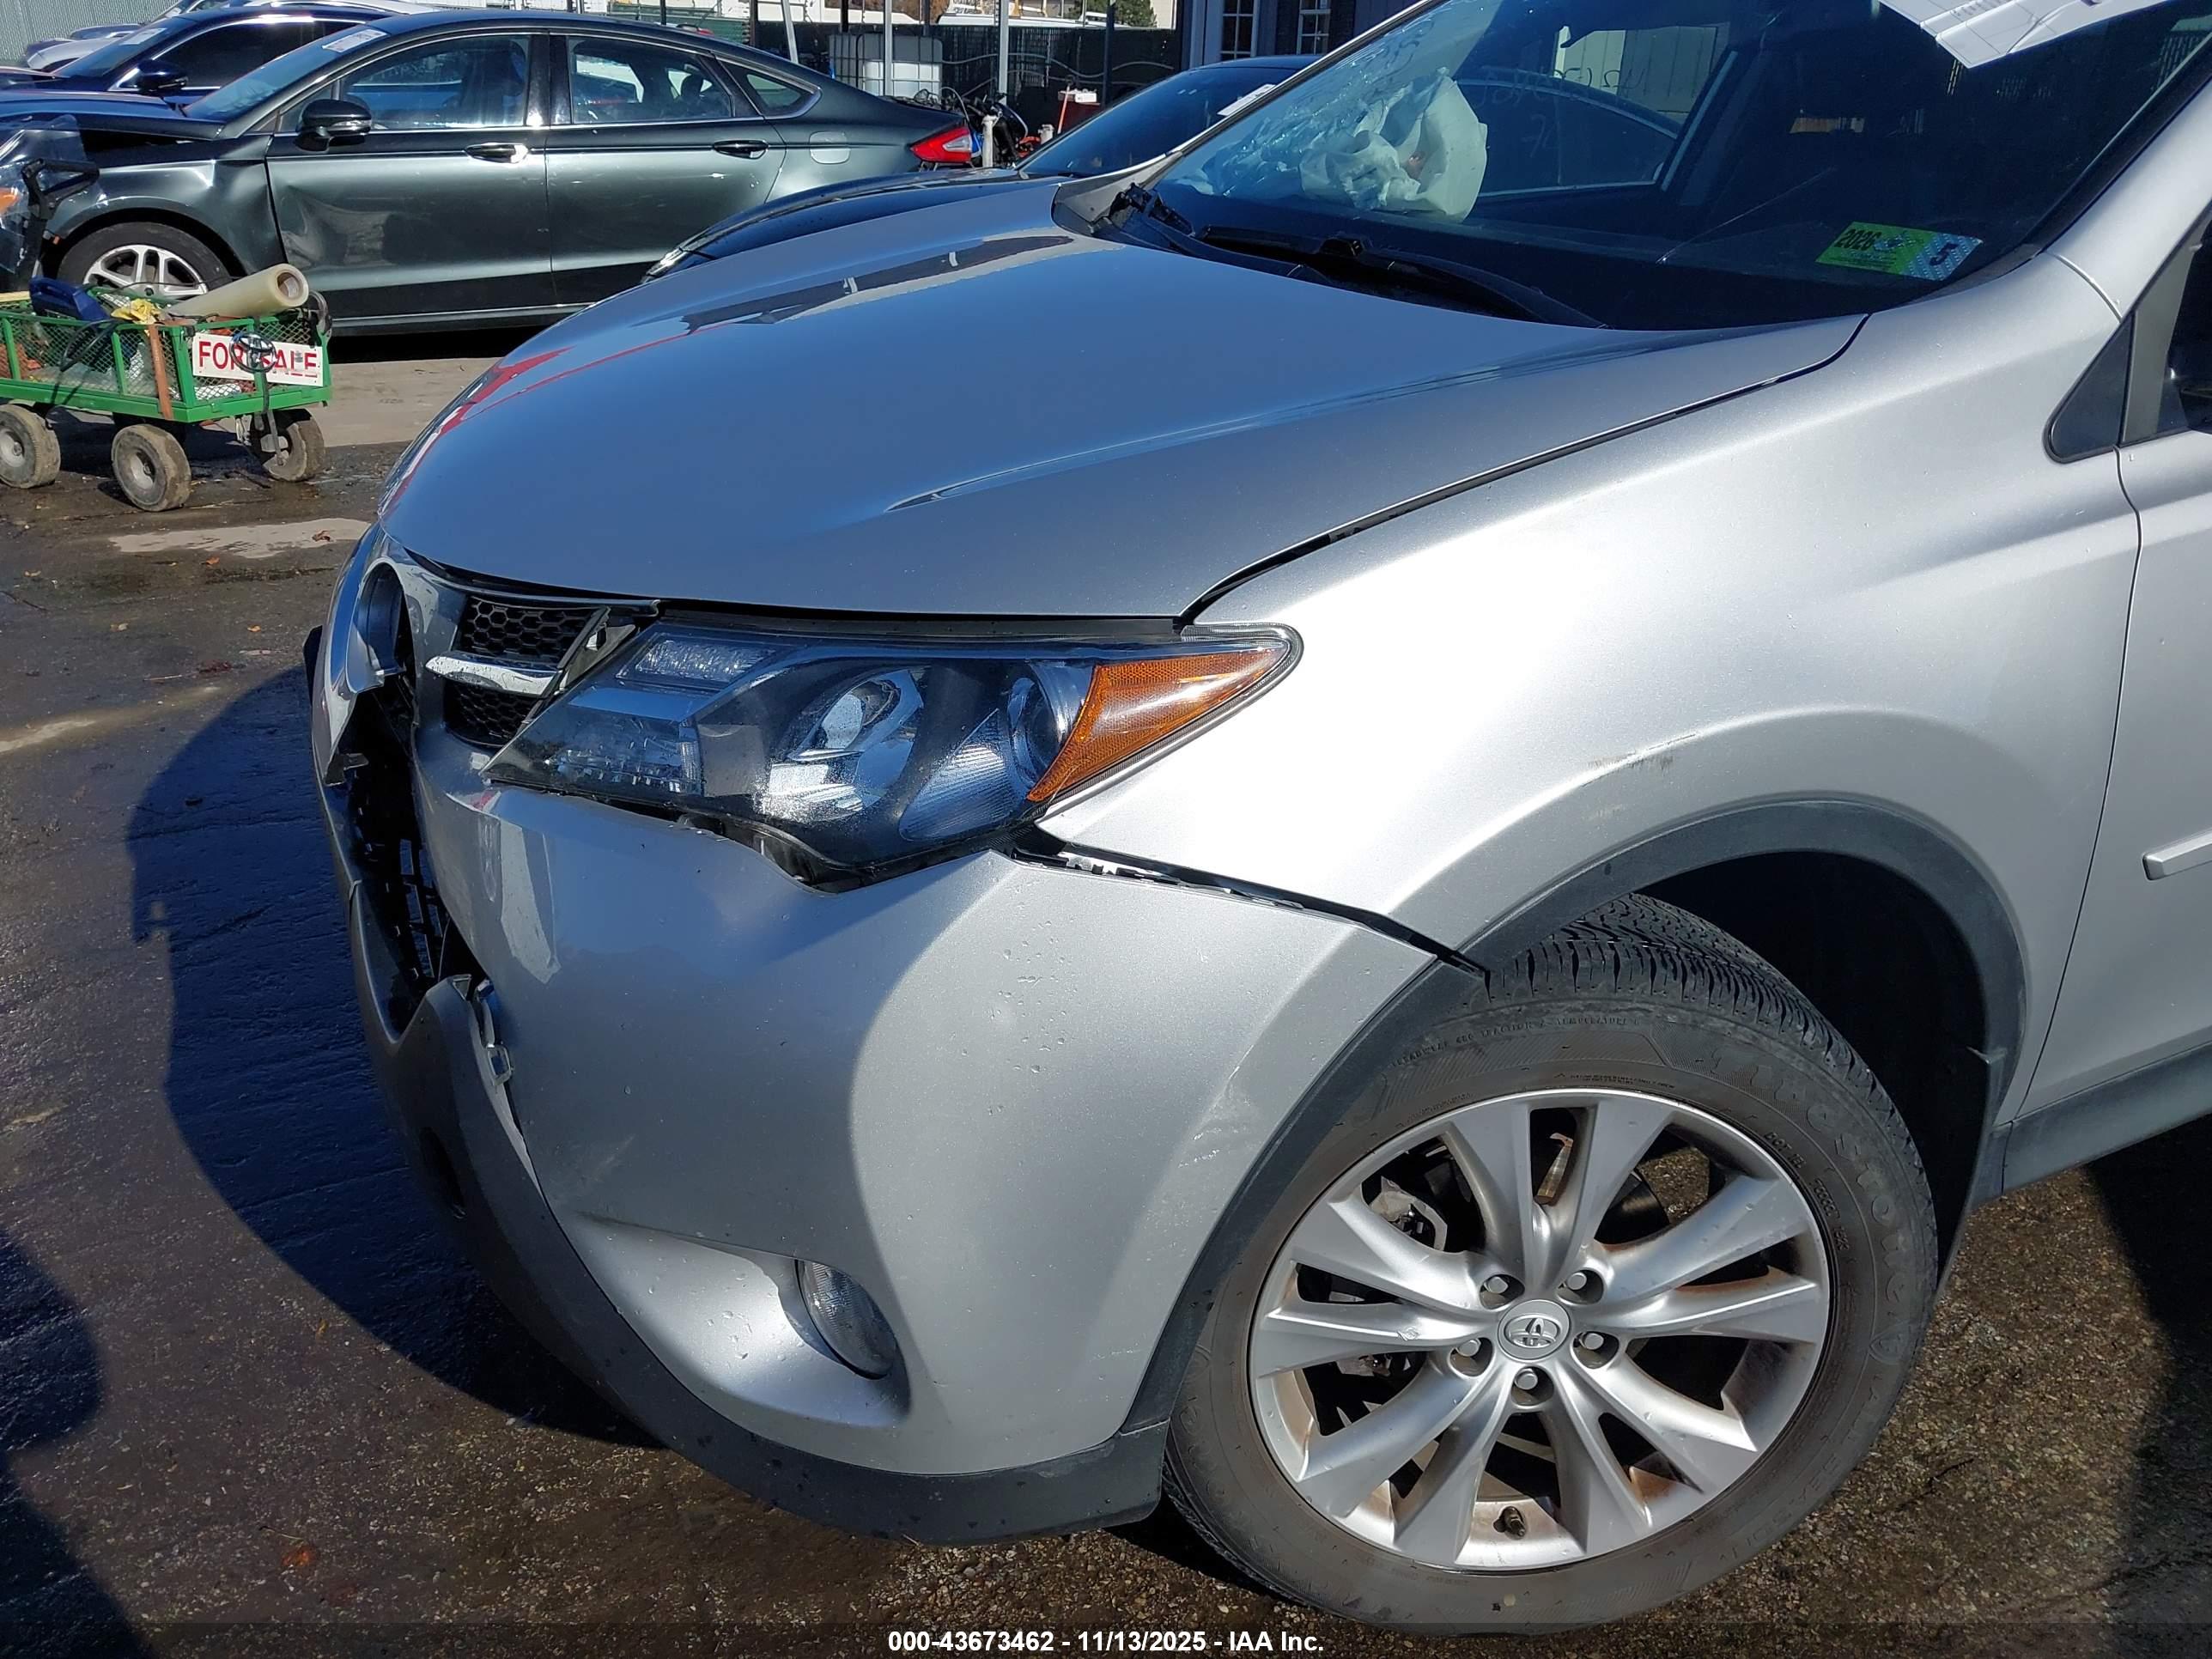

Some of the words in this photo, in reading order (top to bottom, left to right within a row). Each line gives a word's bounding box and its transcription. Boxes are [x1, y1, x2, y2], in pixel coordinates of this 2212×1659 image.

[1834, 228, 1881, 250] 2026
[1929, 242, 1959, 266] 5
[199, 340, 246, 369] FOR
[1764, 1130, 1792, 1152] DOT
[1710, 1044, 1922, 1304] Firestone
